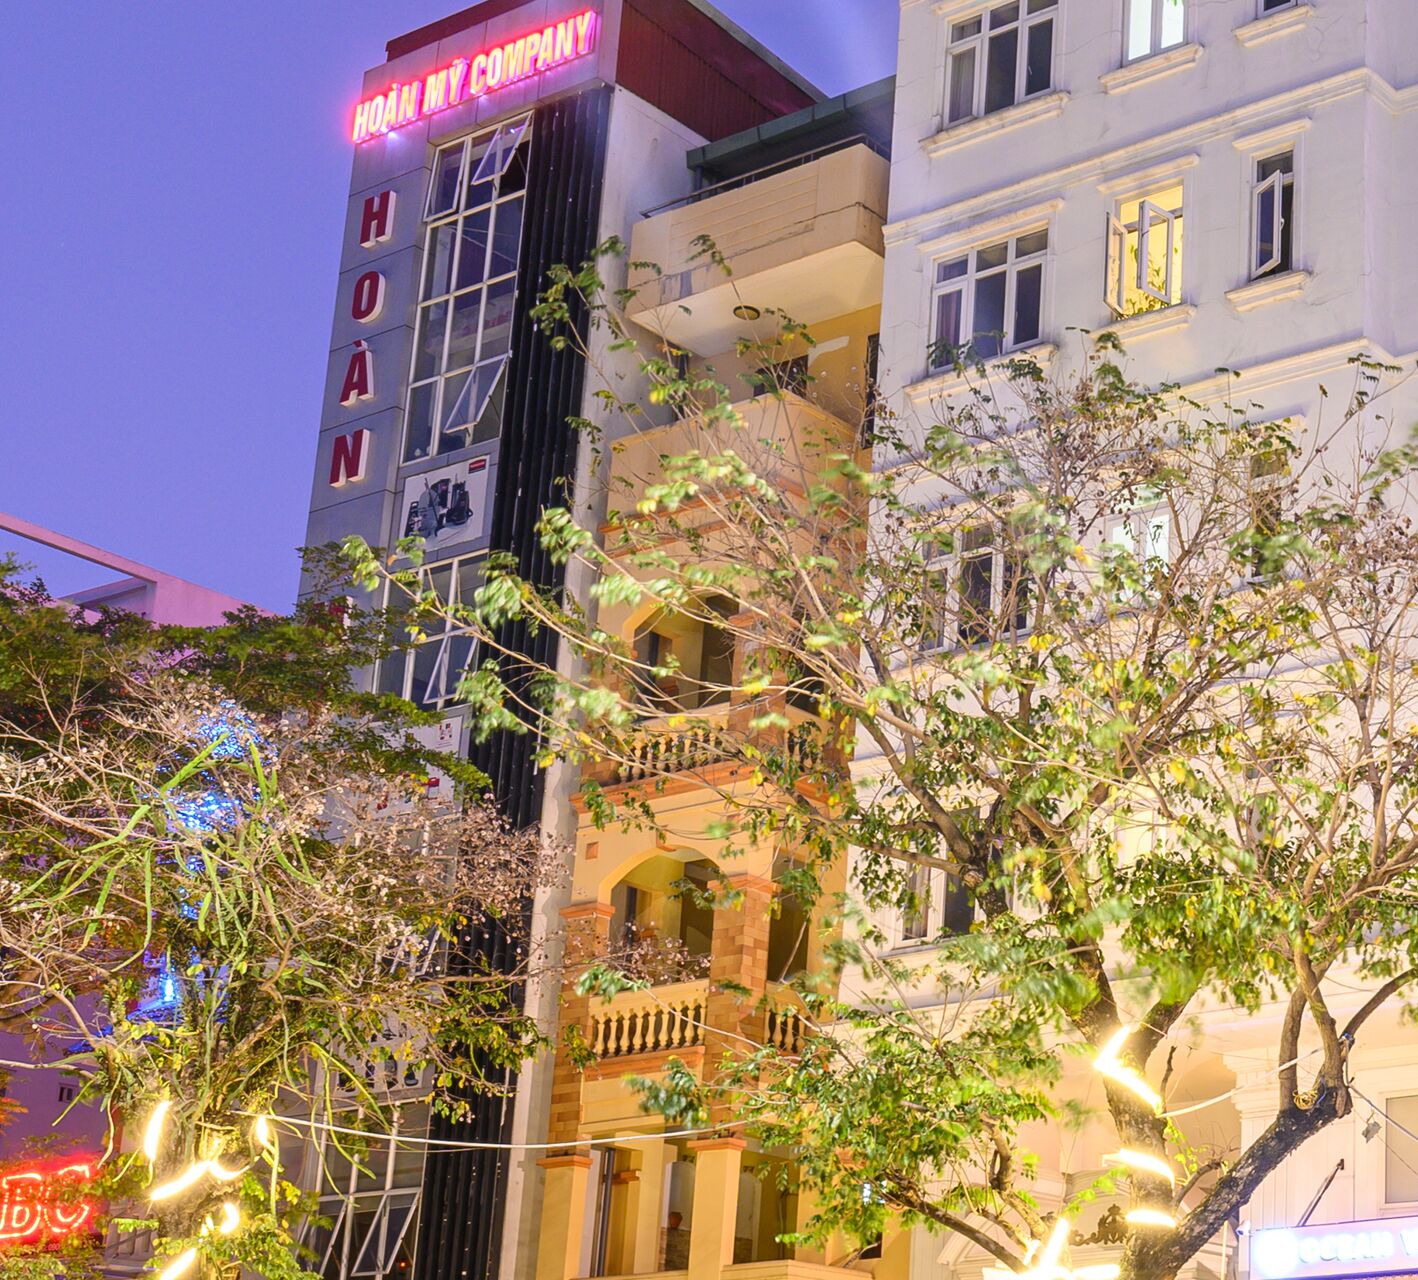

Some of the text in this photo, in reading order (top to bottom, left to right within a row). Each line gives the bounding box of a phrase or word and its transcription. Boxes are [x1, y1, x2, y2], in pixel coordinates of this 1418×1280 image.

[353, 9, 597, 143] HOÀN MỸ COMPANY
[329, 189, 397, 488] HOÀN
